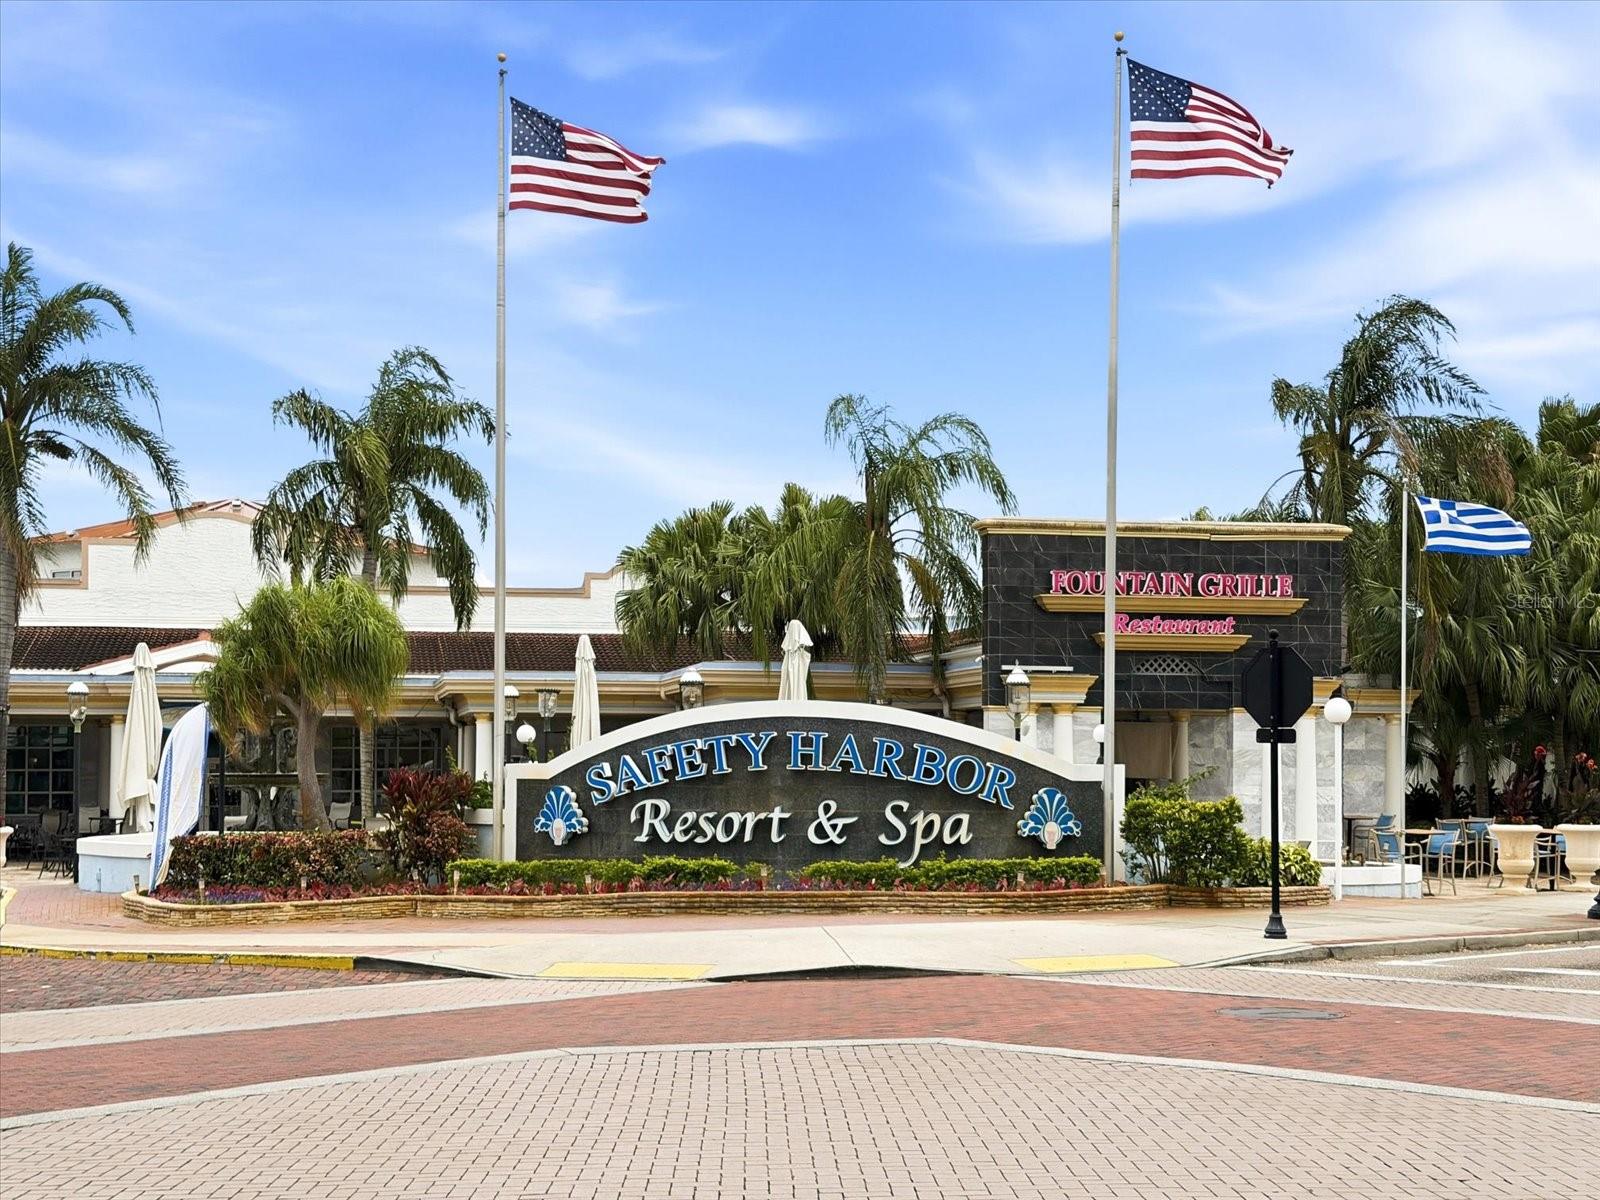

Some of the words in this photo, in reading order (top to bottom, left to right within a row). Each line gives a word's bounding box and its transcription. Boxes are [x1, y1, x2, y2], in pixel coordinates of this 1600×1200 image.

[1050, 569, 1194, 597] FOUNTAIN
[1198, 572, 1294, 598] GRILLE
[1112, 612, 1236, 634] Restaurant
[585, 731, 778, 806] SAFETY
[786, 731, 1016, 810] HARBOR
[630, 799, 792, 844] Resort
[807, 800, 859, 845] &
[878, 800, 974, 868] Spa
